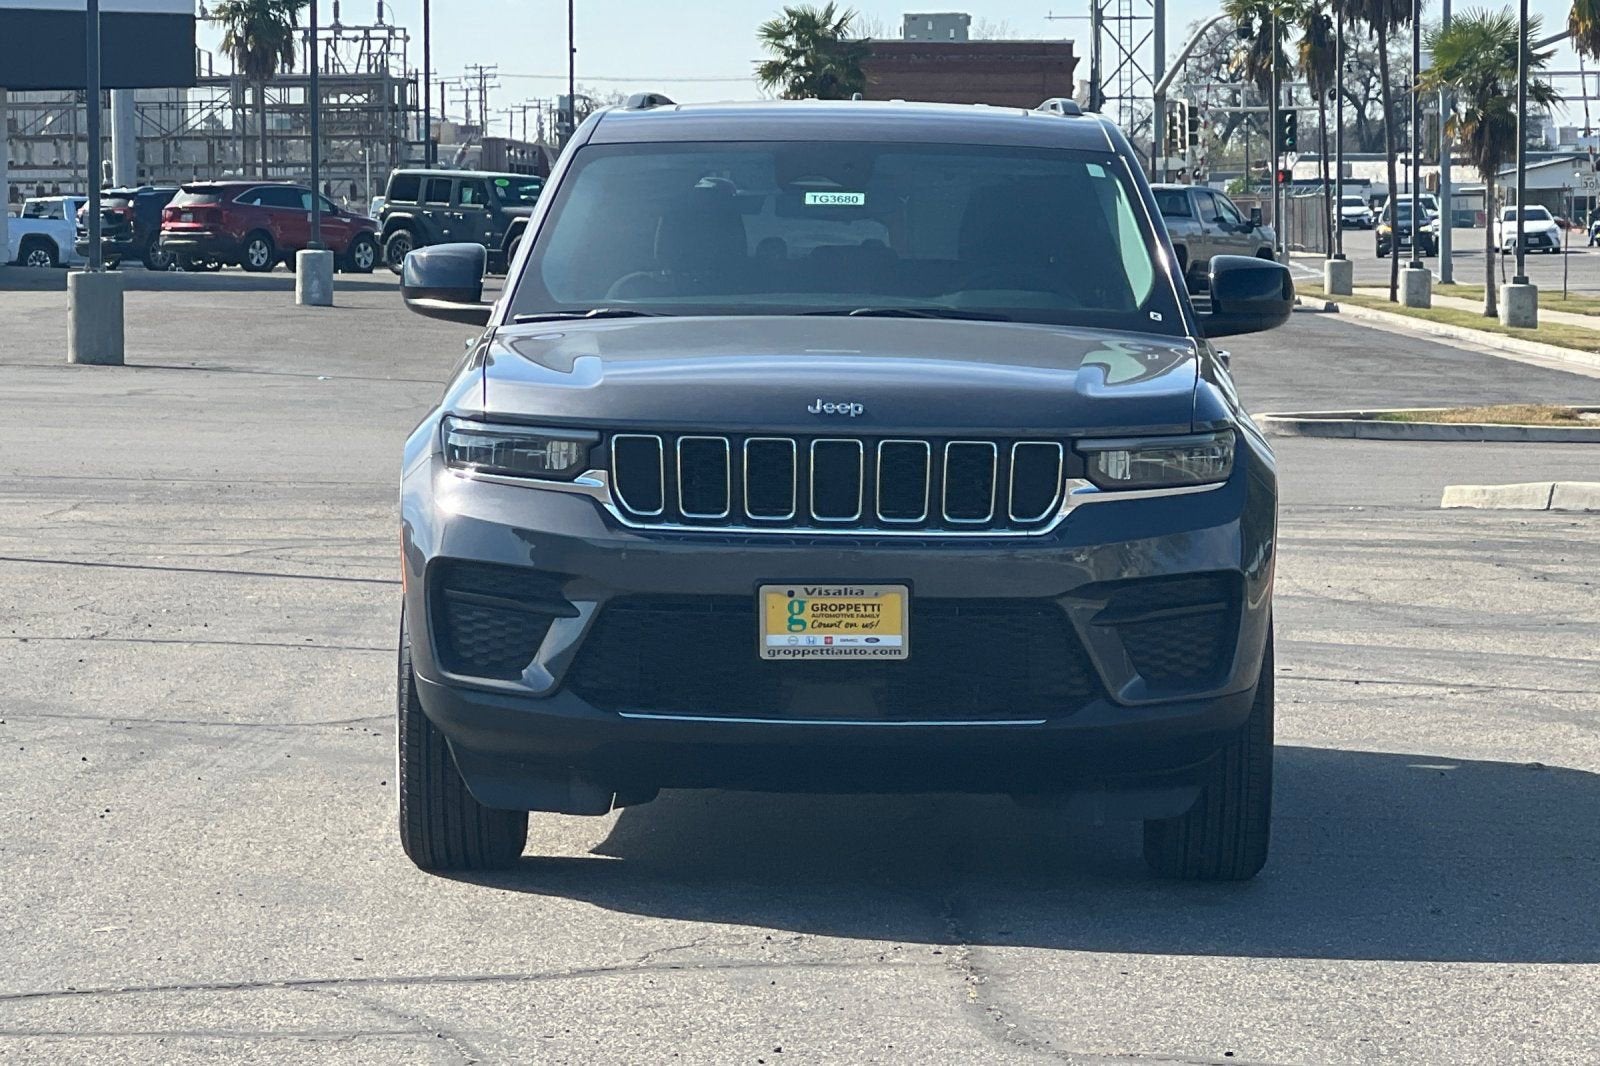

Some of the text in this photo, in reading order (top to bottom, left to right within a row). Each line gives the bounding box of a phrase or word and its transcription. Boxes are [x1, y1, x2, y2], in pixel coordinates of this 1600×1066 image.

[811, 195, 858, 203] TG3680
[807, 398, 864, 417] Jeep
[804, 587, 865, 596] Visalia
[811, 603, 881, 612] GROPPETTI
[811, 619, 842, 629] Count
[767, 647, 902, 657] groppettiauto.com
